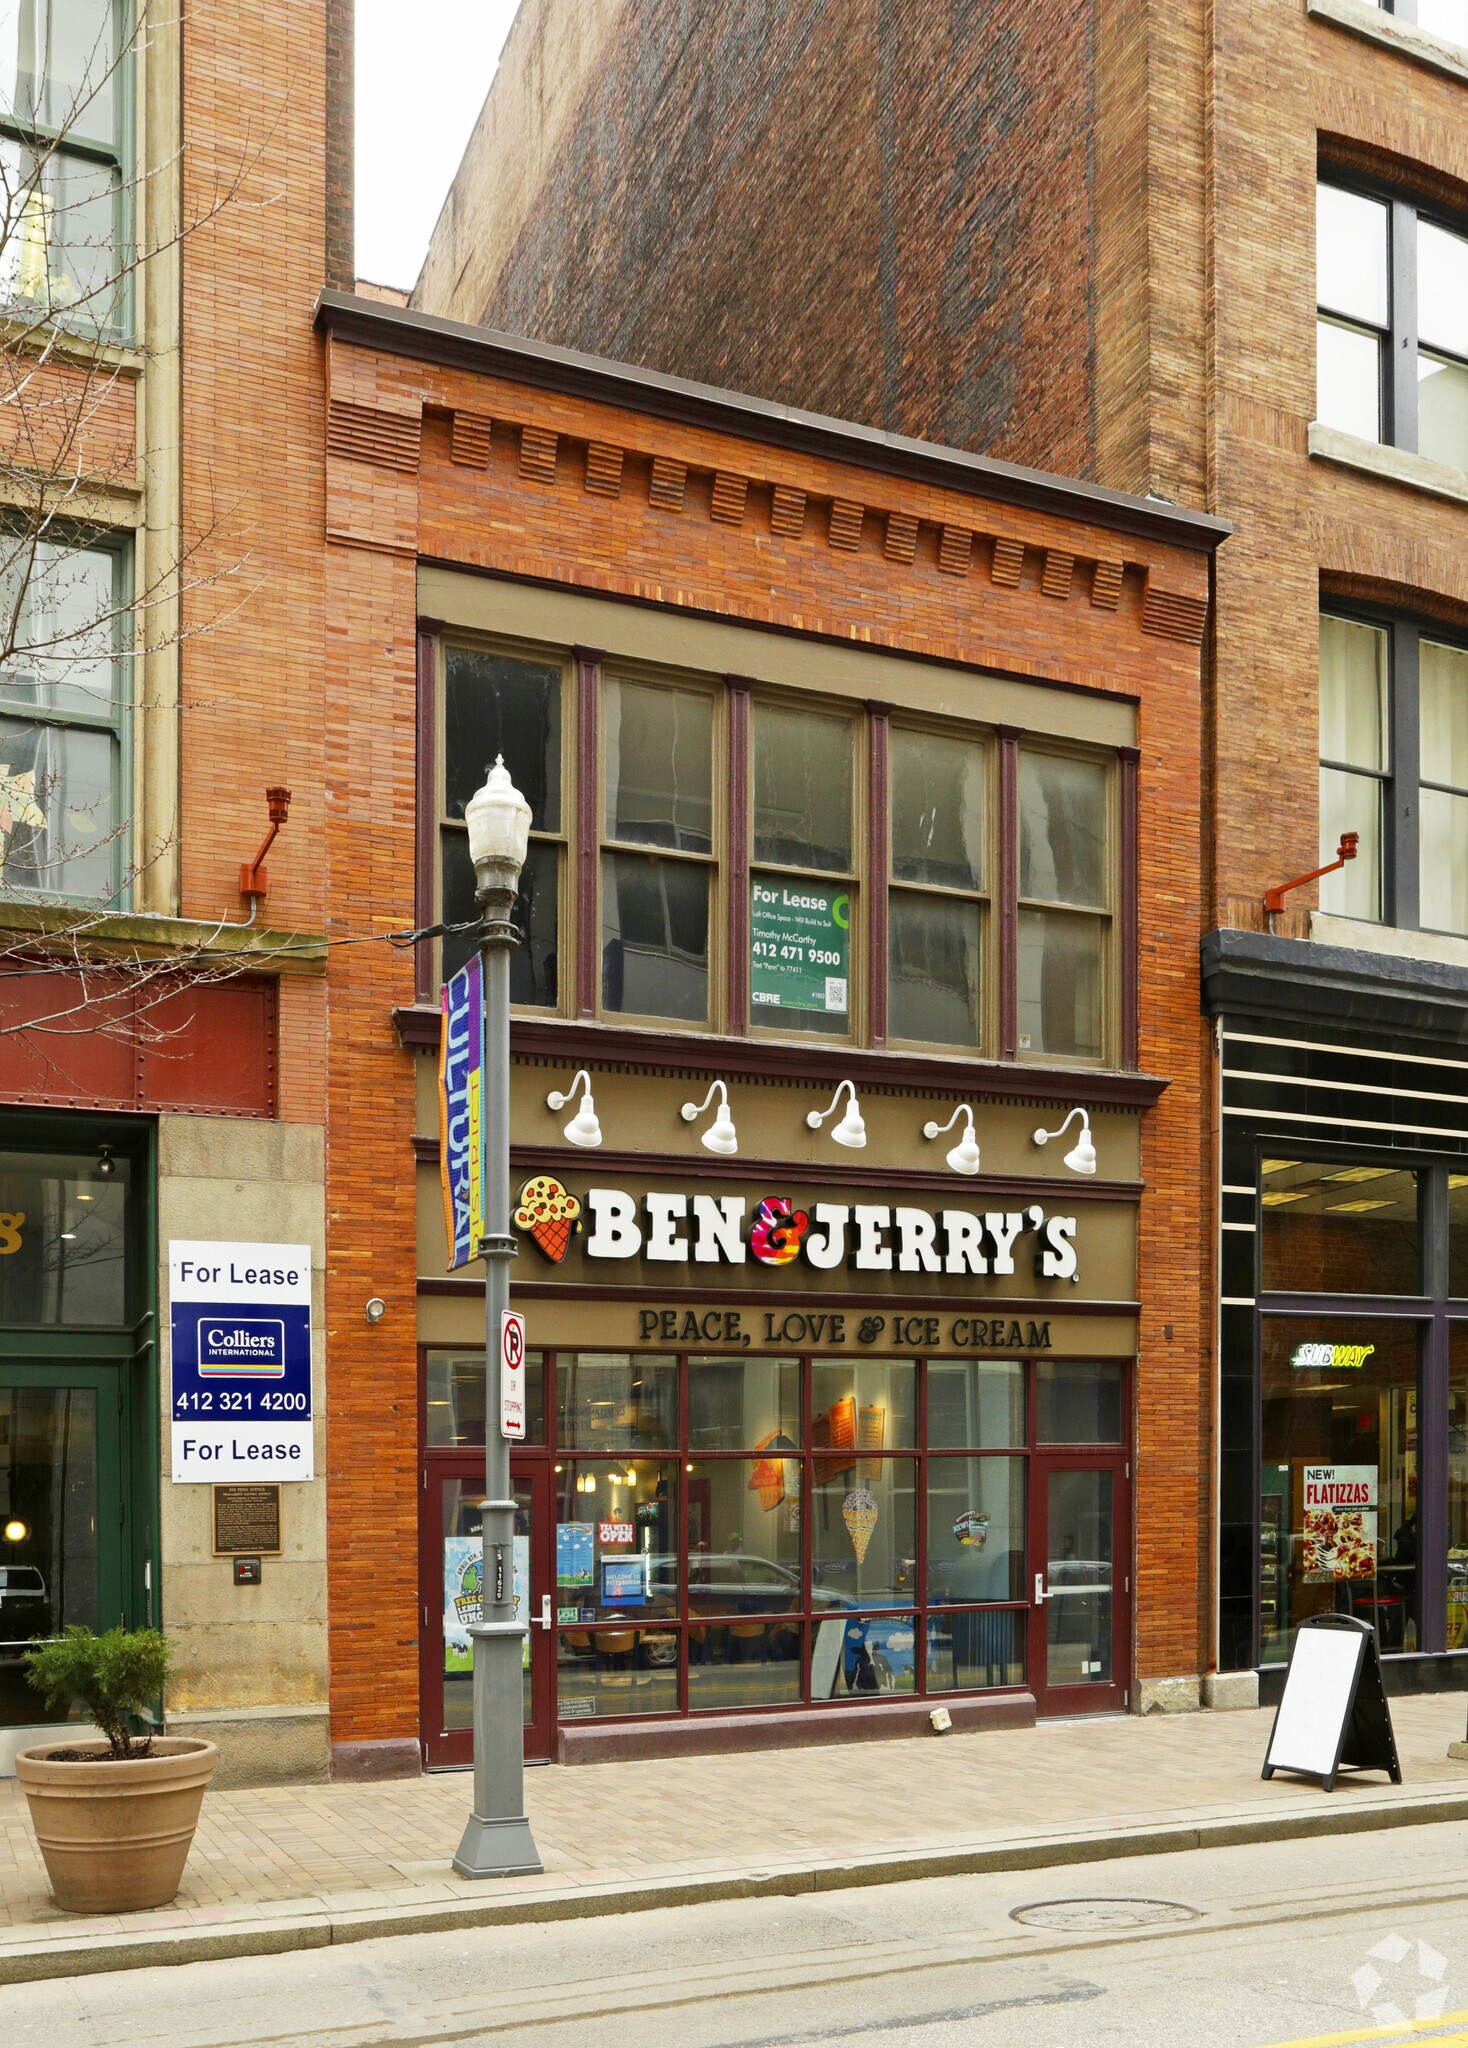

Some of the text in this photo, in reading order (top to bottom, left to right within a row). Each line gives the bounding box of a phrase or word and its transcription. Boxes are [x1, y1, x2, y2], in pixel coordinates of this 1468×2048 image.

[753, 885, 828, 911] For Lease
[761, 912, 777, 920] Office
[777, 914, 791, 923] Space
[795, 916, 805, 924] Will
[805, 917, 817, 926] Build
[752, 927, 817, 947] Timothy McCarthy
[752, 942, 841, 966] 412 471 9500
[786, 965, 802, 974] 77411
[752, 991, 781, 1005] CBRE
[447, 966, 471, 1262] CULTURAL
[469, 1079, 482, 1258] DISTRICT
[586, 1188, 747, 1264] BEN
[807, 1203, 1078, 1278] JERRY'S
[180, 1261, 299, 1287] For Lease
[640, 1308, 1052, 1349] PEACE, LOVE & ICE CREAM
[207, 1328, 276, 1349] Colliers
[208, 1349, 275, 1357] INTERNATIONAL
[1292, 1343, 1375, 1367] SUBWAY
[176, 1392, 307, 1411] 412 321 4200
[504, 1399, 523, 1414] STOPPING
[183, 1440, 302, 1461] For Lease
[1307, 1469, 1335, 1480] NEW!
[1306, 1483, 1370, 1505] FLATIZZAS
[599, 1523, 633, 1531] YES WE'RE
[599, 1530, 633, 1543] OPEN
[606, 1573, 641, 1582] WELCOME TO
[455, 1596, 477, 1607] FREE
[457, 1603, 482, 1615] LEAVE
